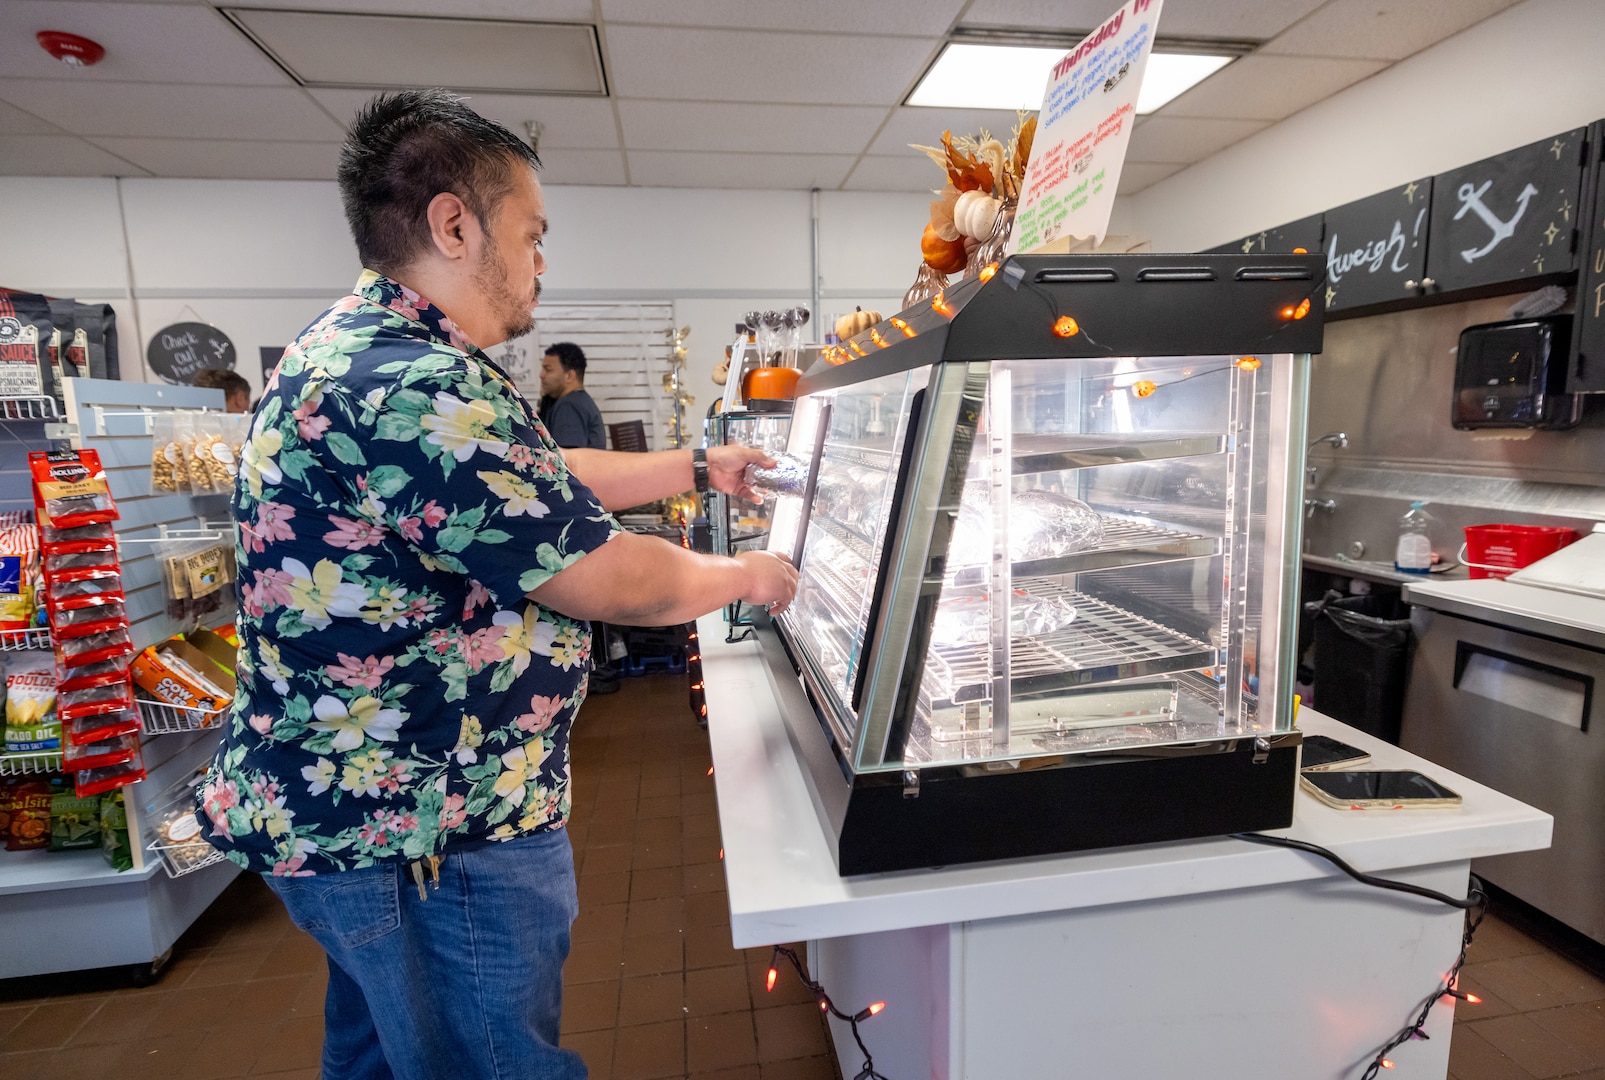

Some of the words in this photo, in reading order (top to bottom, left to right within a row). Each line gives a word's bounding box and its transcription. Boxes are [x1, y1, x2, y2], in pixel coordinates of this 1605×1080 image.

[1053, 9, 1125, 81] Thursday
[161, 331, 199, 350] Check
[1, 344, 36, 361] SAUCE
[174, 345, 198, 366] out
[6, 674, 58, 690] BOULDE
[161, 677, 194, 701] COW
[153, 683, 188, 706] TALES
[36, 727, 57, 740] OIL
